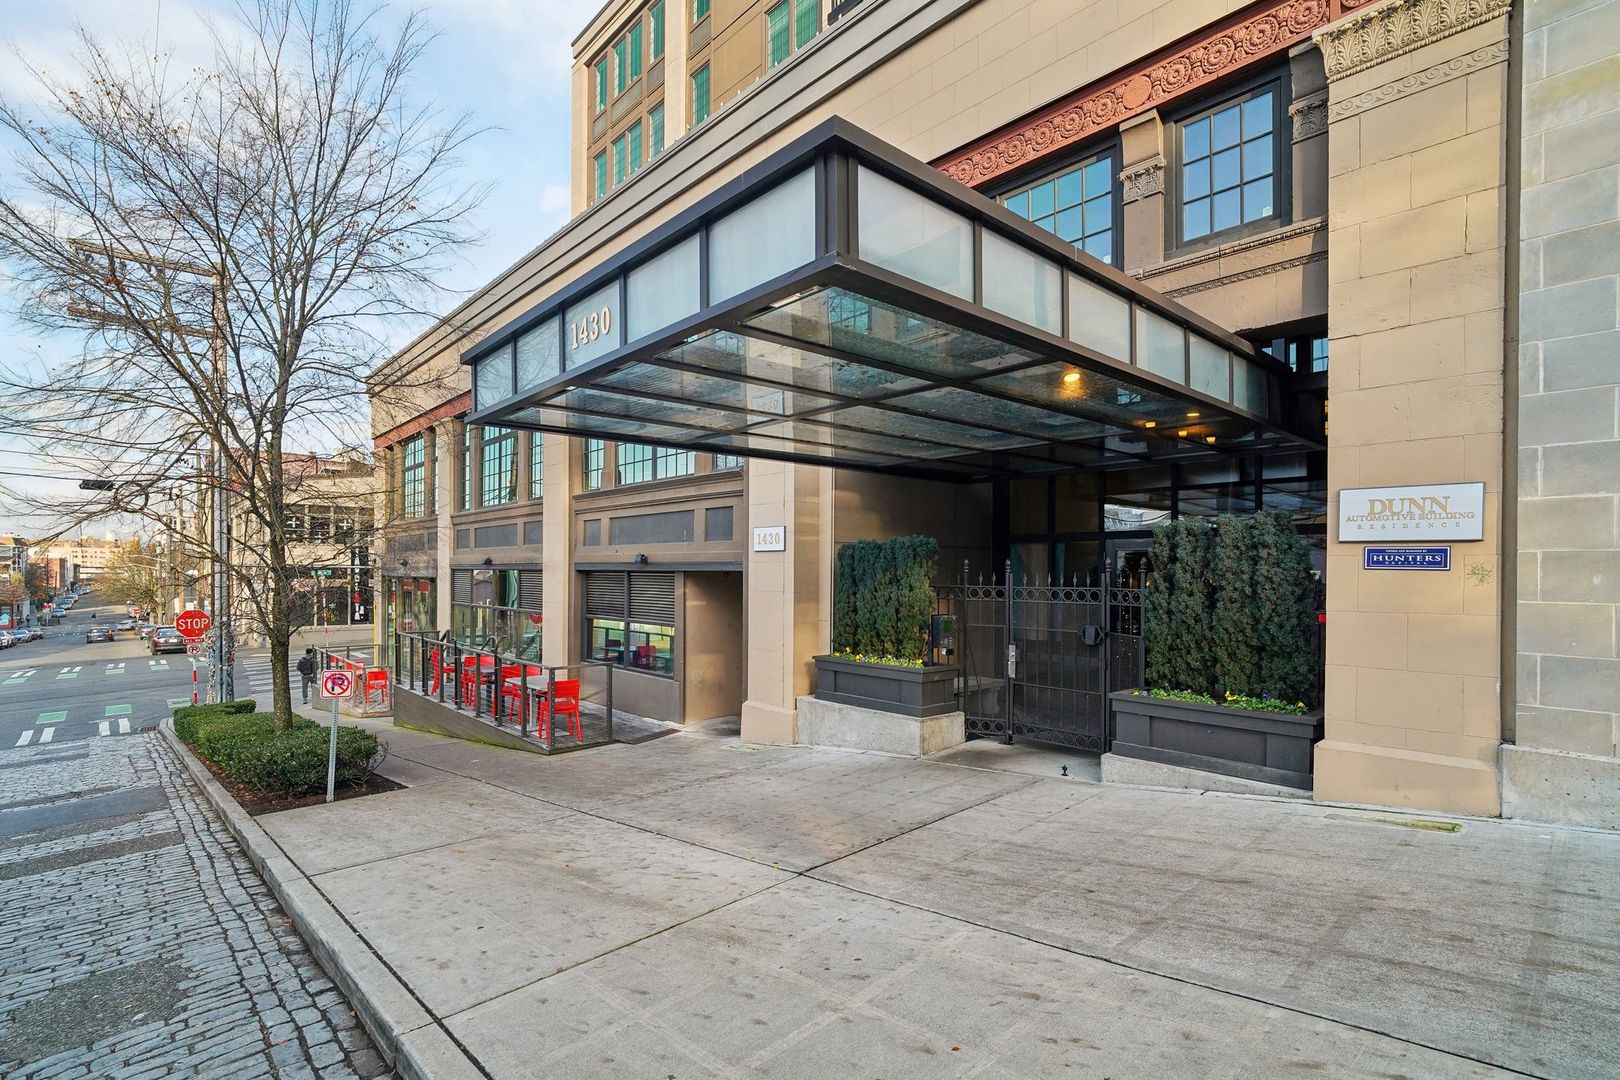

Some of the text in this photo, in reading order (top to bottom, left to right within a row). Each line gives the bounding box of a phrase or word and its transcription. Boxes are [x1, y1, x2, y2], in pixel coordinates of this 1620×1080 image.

[572, 306, 611, 350] 1430
[1368, 496, 1450, 514] DUNN
[1346, 511, 1475, 522] AUTOMOTIVE BUILDING
[1357, 521, 1460, 530] RESIDENCE
[757, 532, 780, 545] 1430
[178, 618, 209, 630] STOP
